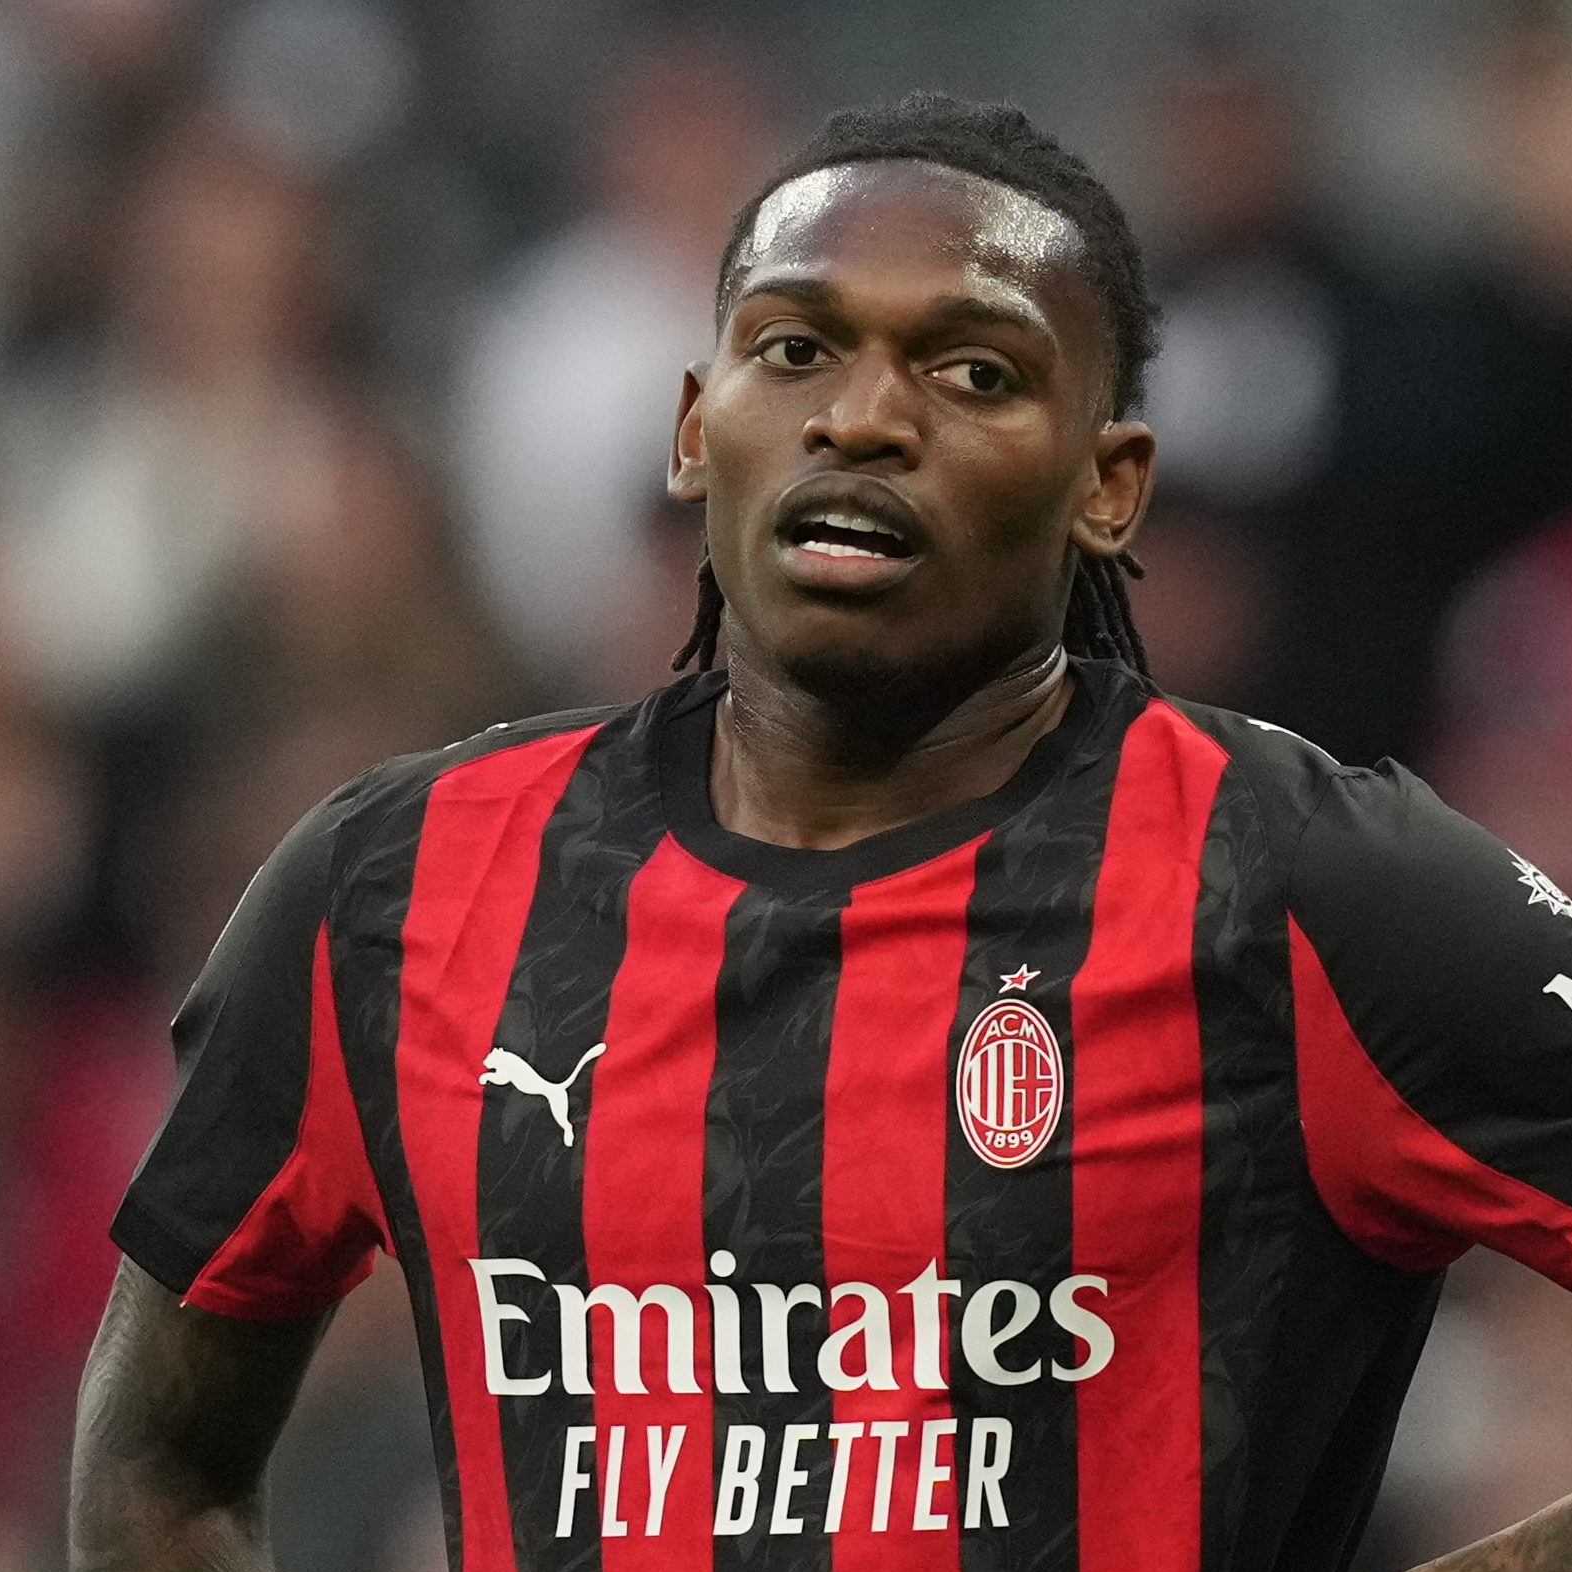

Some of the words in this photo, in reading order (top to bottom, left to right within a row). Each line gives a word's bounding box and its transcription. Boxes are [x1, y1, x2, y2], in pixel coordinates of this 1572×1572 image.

[981, 1013, 1040, 1045] ACM
[984, 1129, 1034, 1149] 1899
[466, 1249, 1115, 1396] Emirates
[554, 1425, 687, 1538] FLY
[713, 1417, 1014, 1536] BETTER
